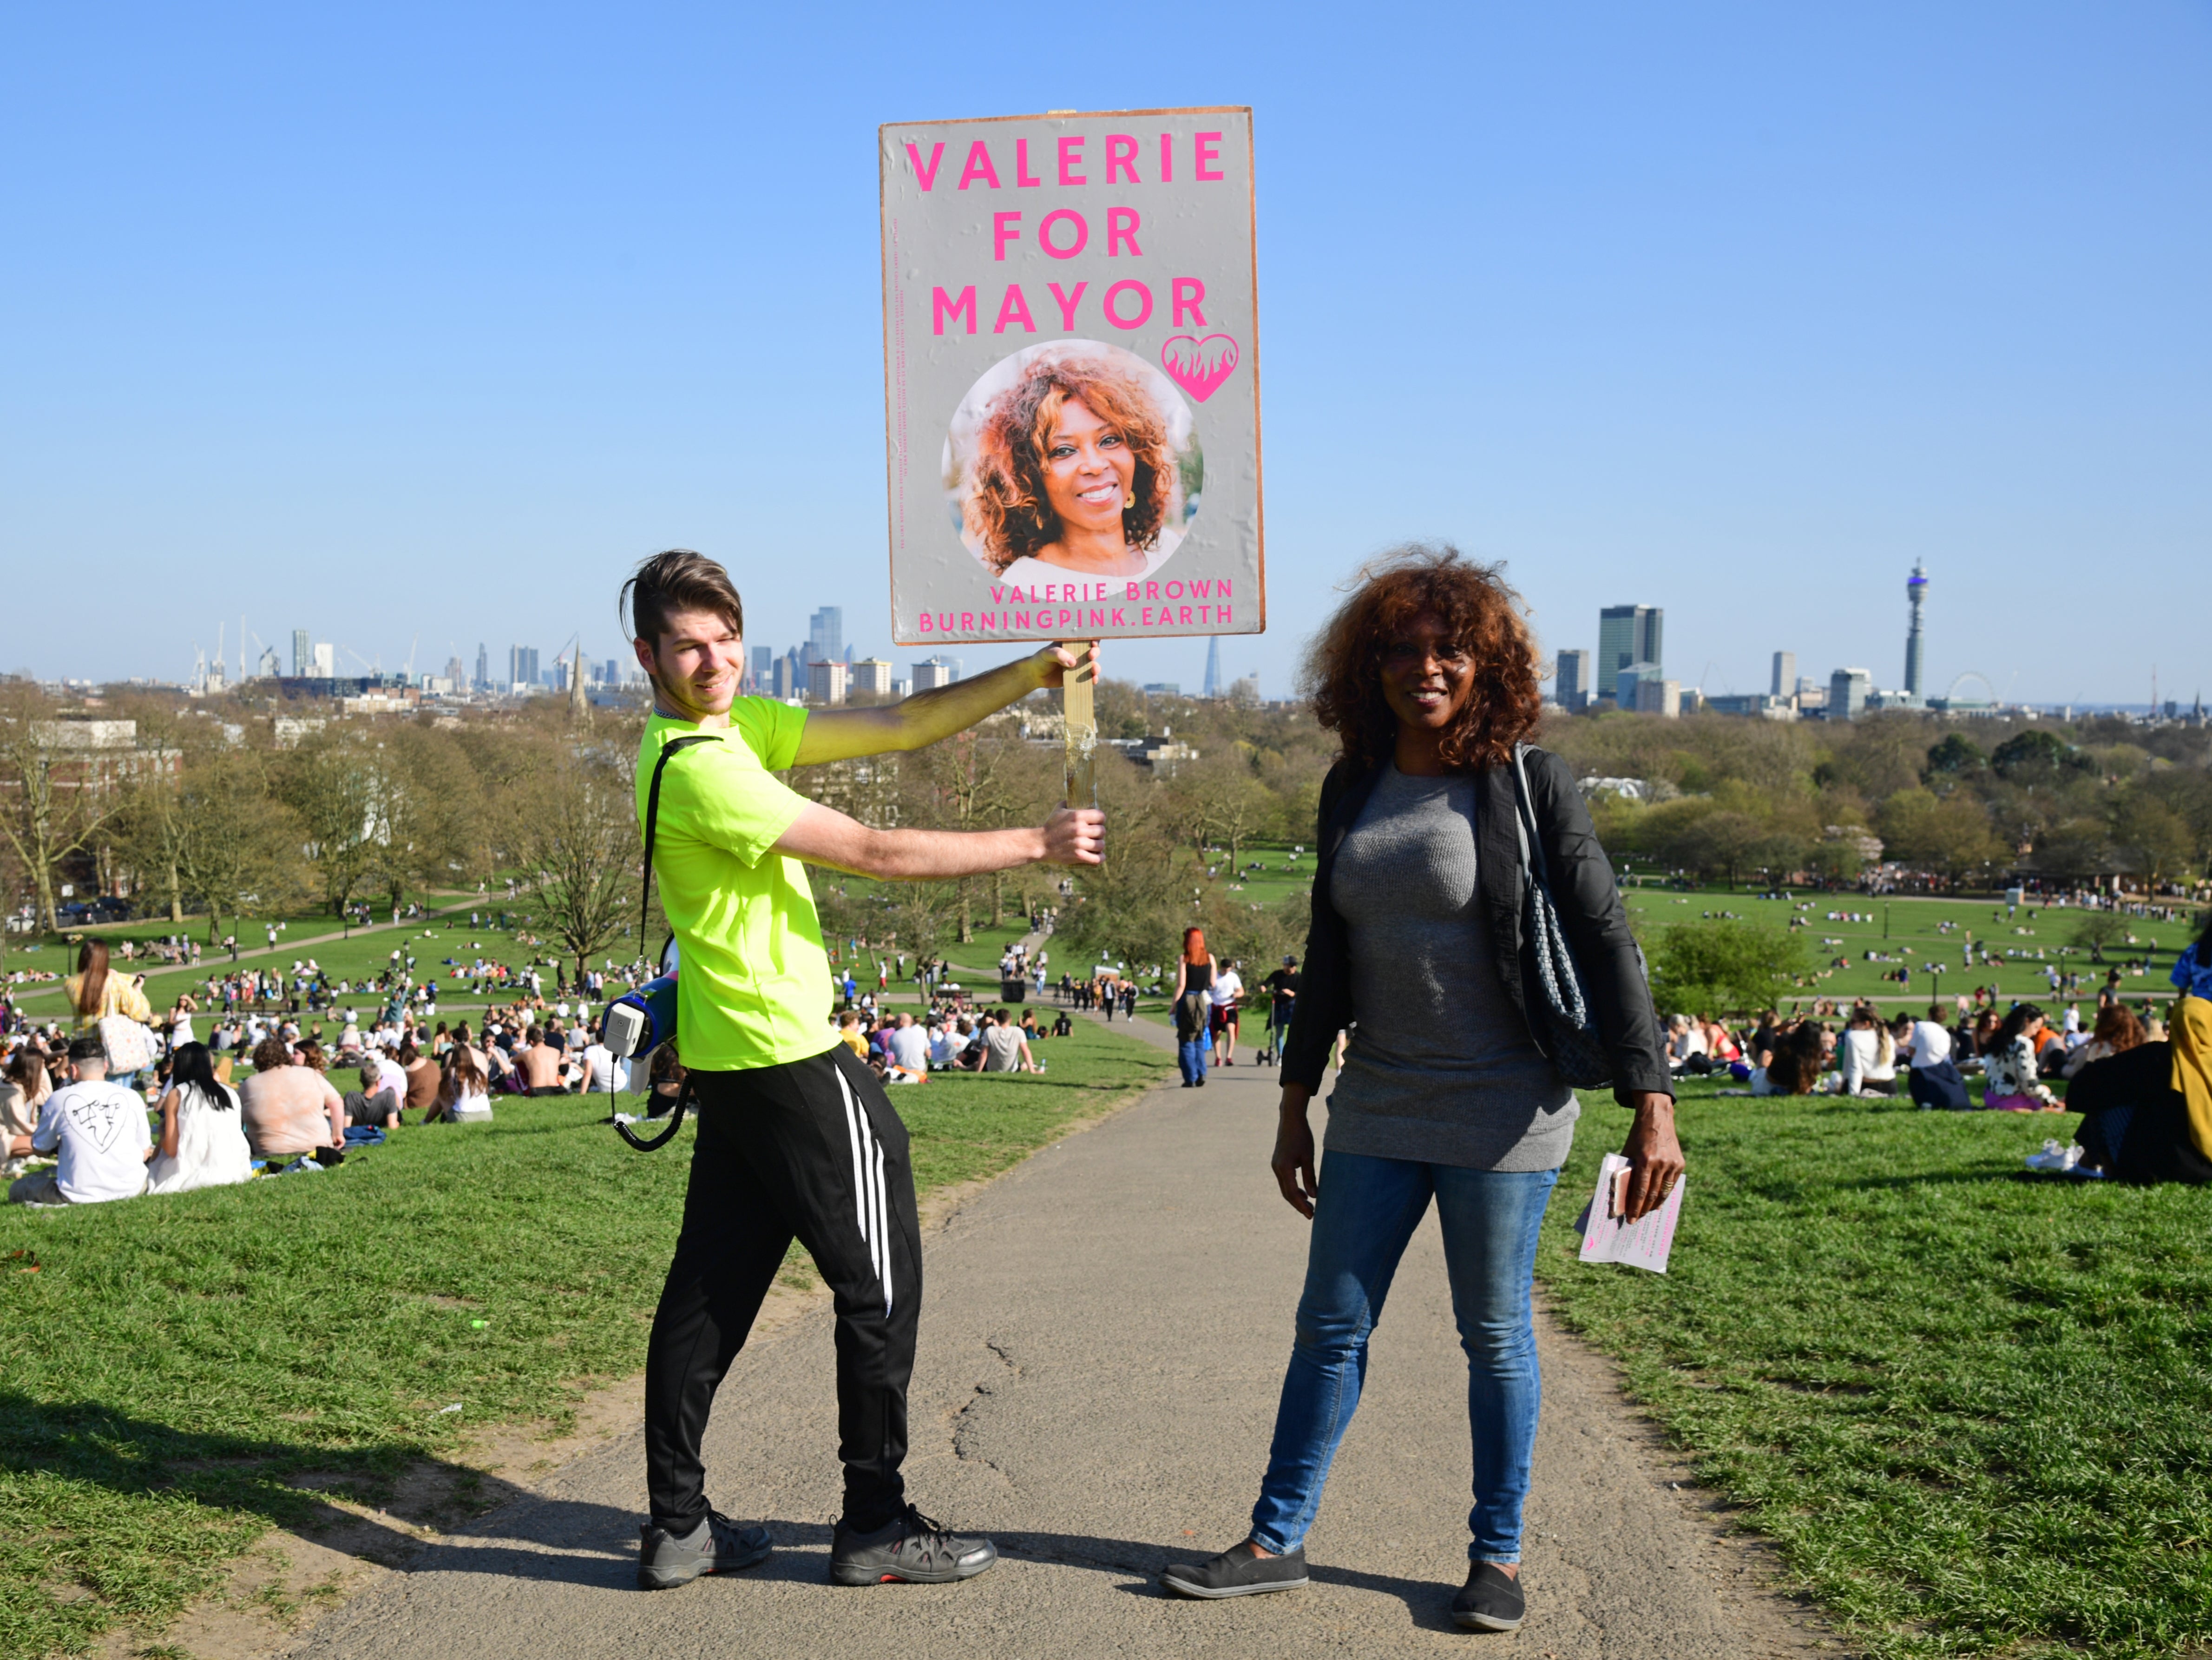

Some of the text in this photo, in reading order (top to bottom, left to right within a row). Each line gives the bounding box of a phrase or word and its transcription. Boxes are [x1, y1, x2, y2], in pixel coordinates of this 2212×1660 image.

[906, 132, 1224, 191] VALERIE
[994, 207, 1142, 261] FOR
[932, 277, 1207, 336] MAYOR
[920, 605, 1232, 632] BURNINGPINK.EARTH
[991, 580, 1232, 604] VALERIE BROWN
